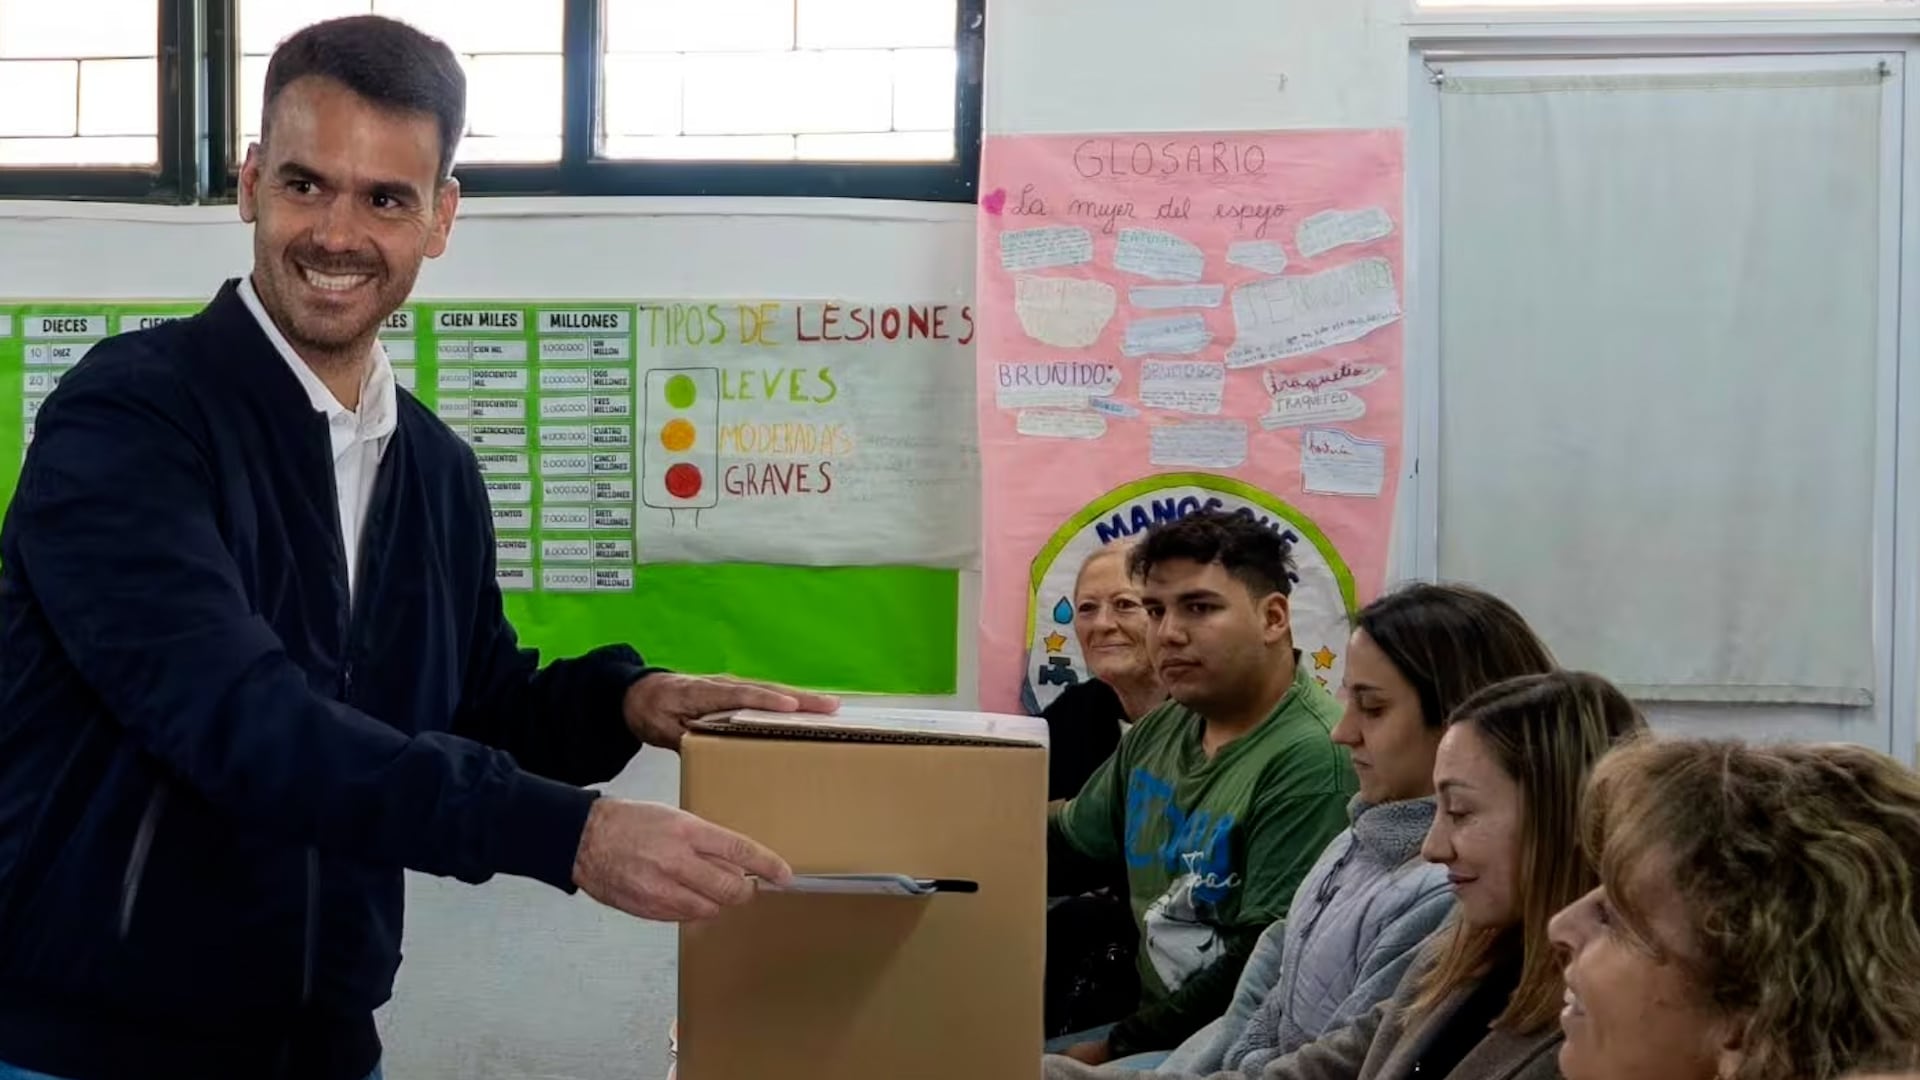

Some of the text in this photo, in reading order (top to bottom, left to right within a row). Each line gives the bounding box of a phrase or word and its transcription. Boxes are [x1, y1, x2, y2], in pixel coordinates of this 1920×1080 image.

[1074, 140, 1266, 178] GLOSARIO
[1011, 184, 1048, 216] La
[1068, 199, 1137, 234] mujer
[1154, 197, 1192, 220] del
[1213, 202, 1293, 239] espejo
[43, 318, 88, 333] DIECES
[382, 313, 407, 328] LES
[441, 312, 518, 327] CIEN MILES
[550, 313, 618, 328] MILLONES
[640, 303, 727, 347] TIPOS
[738, 302, 783, 347] DE
[796, 303, 976, 345] LESIONES
[29, 348, 42, 358] 10
[53, 348, 71, 358] DIEZ
[721, 366, 838, 404] LEVES
[725, 461, 833, 497] GRAVES
[493, 510, 522, 518] CIENTOS
